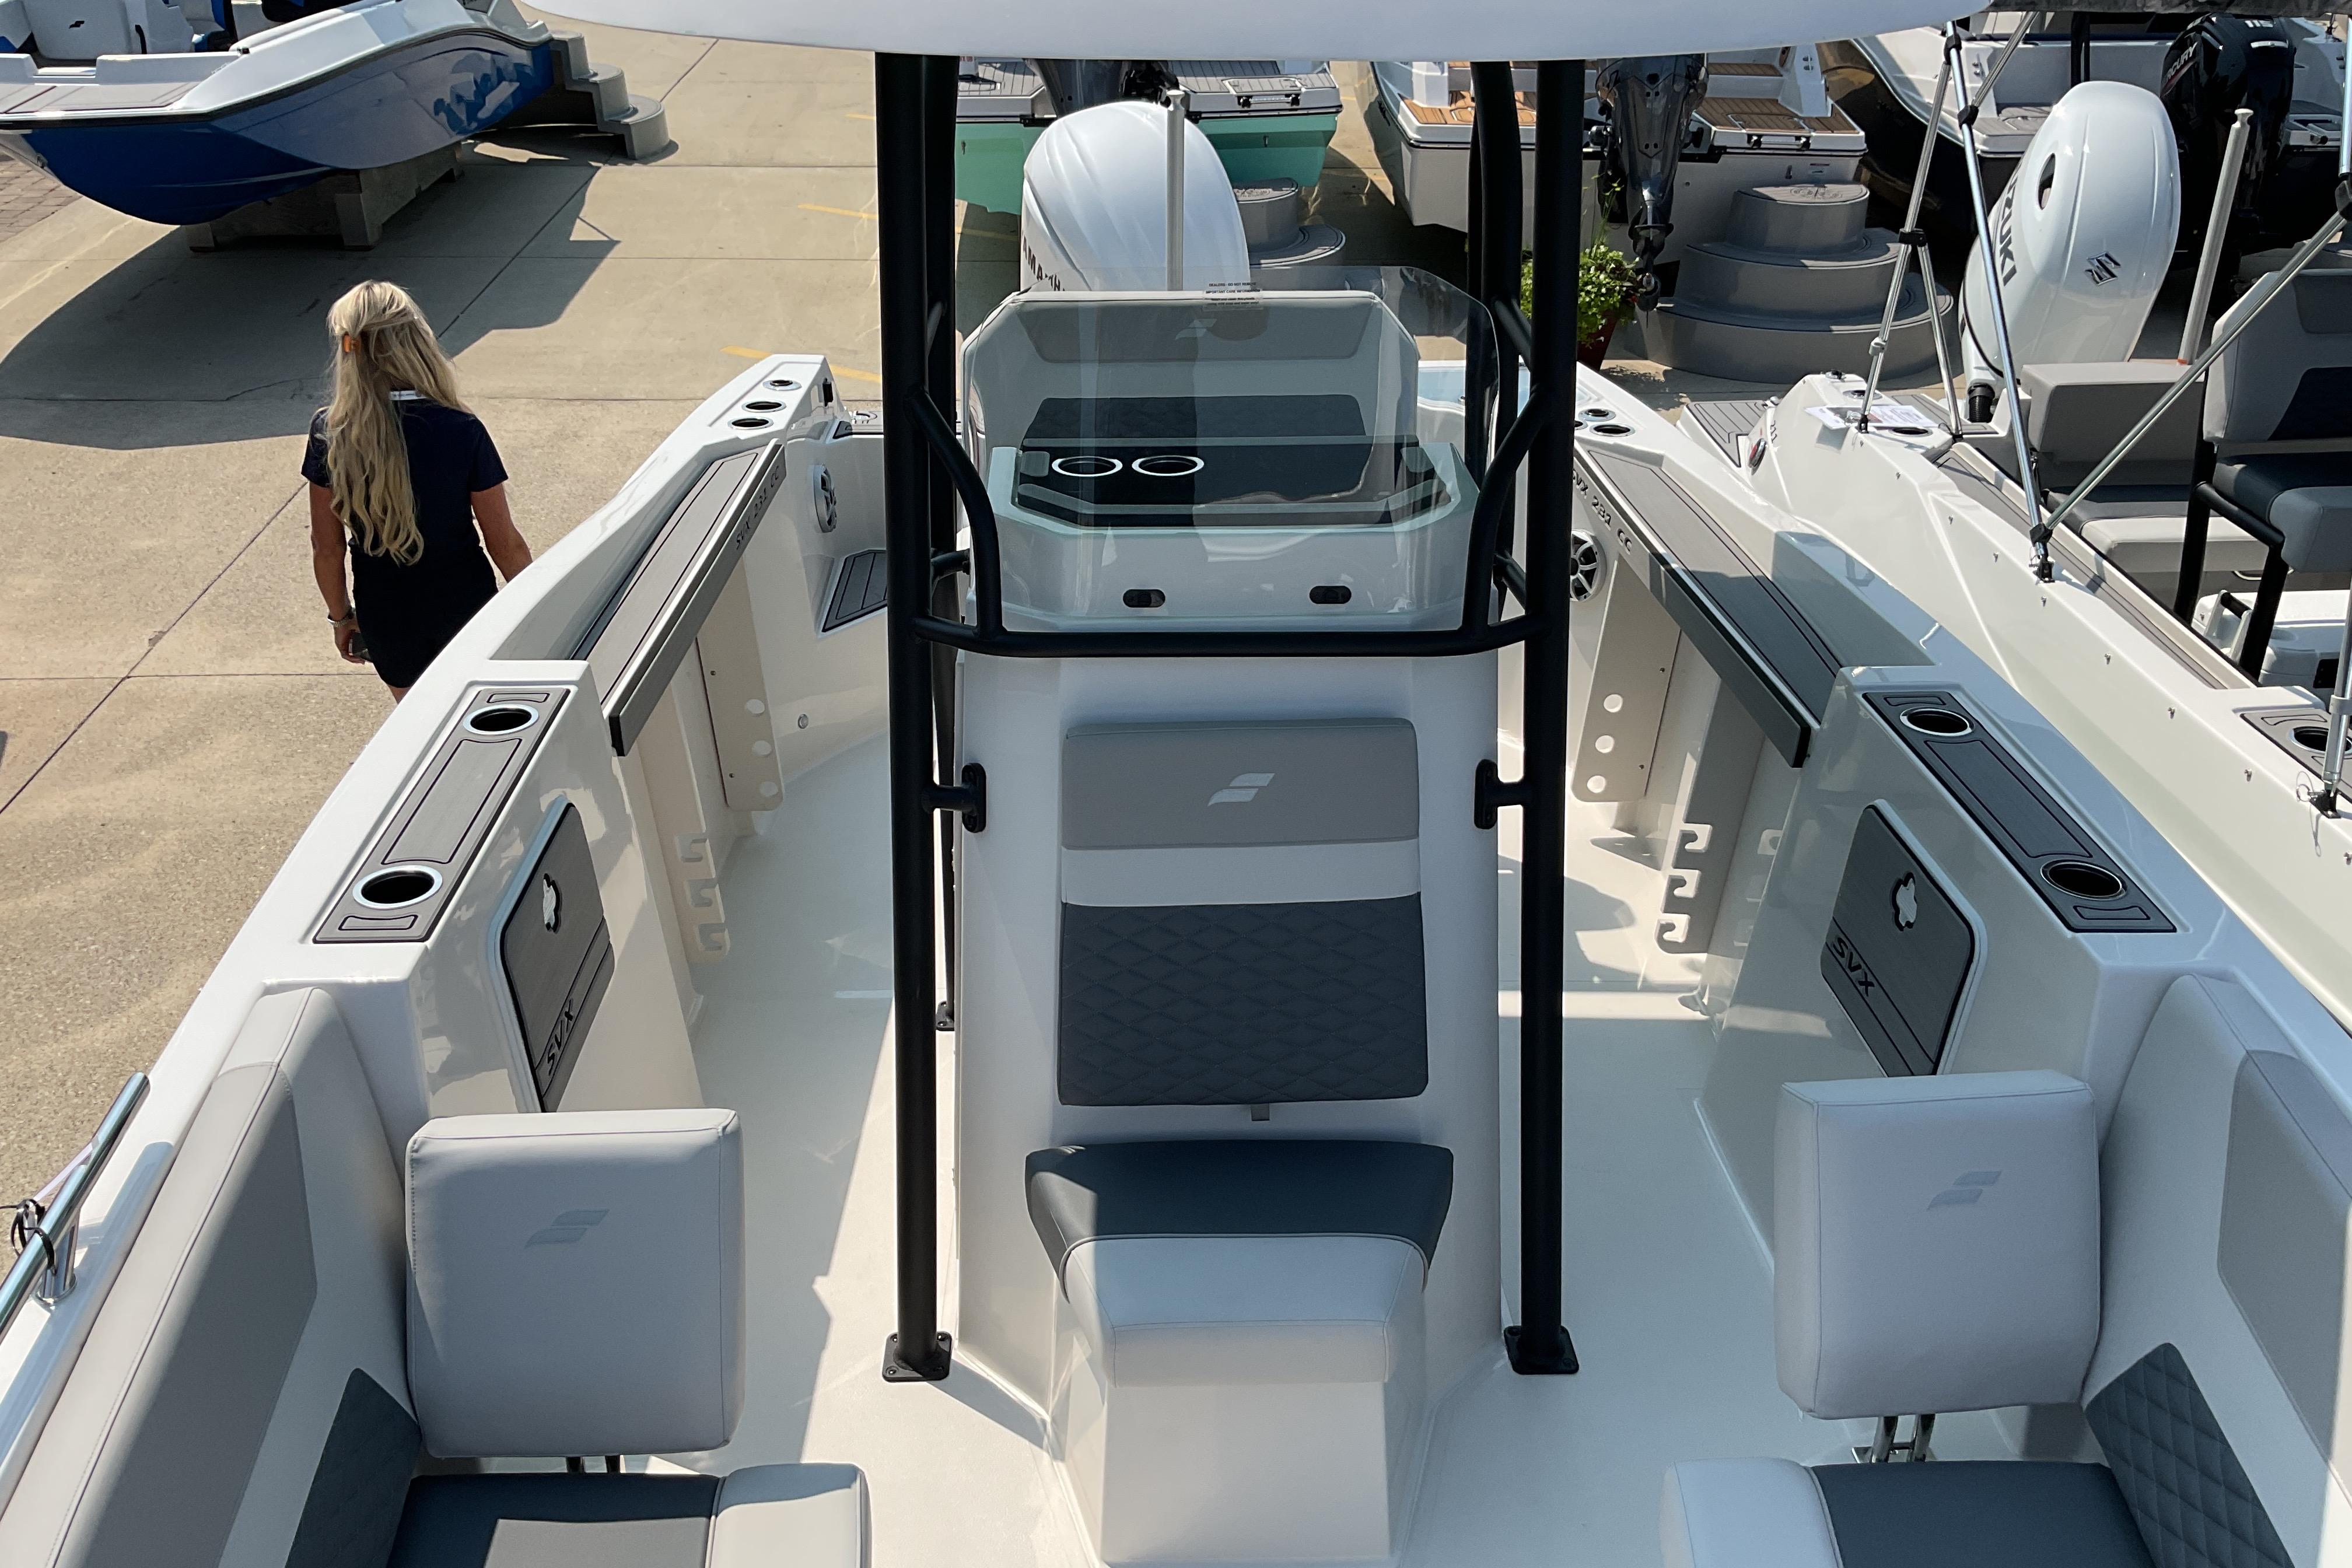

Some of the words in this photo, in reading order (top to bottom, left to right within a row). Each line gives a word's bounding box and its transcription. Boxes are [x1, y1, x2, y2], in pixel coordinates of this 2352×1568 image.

[2000, 162, 2022, 286] UZUKI
[1591, 495, 1611, 530] 231
[1617, 528, 1633, 554] CC
[1832, 936, 1875, 997] SVX
[547, 998, 573, 1076] SVX
